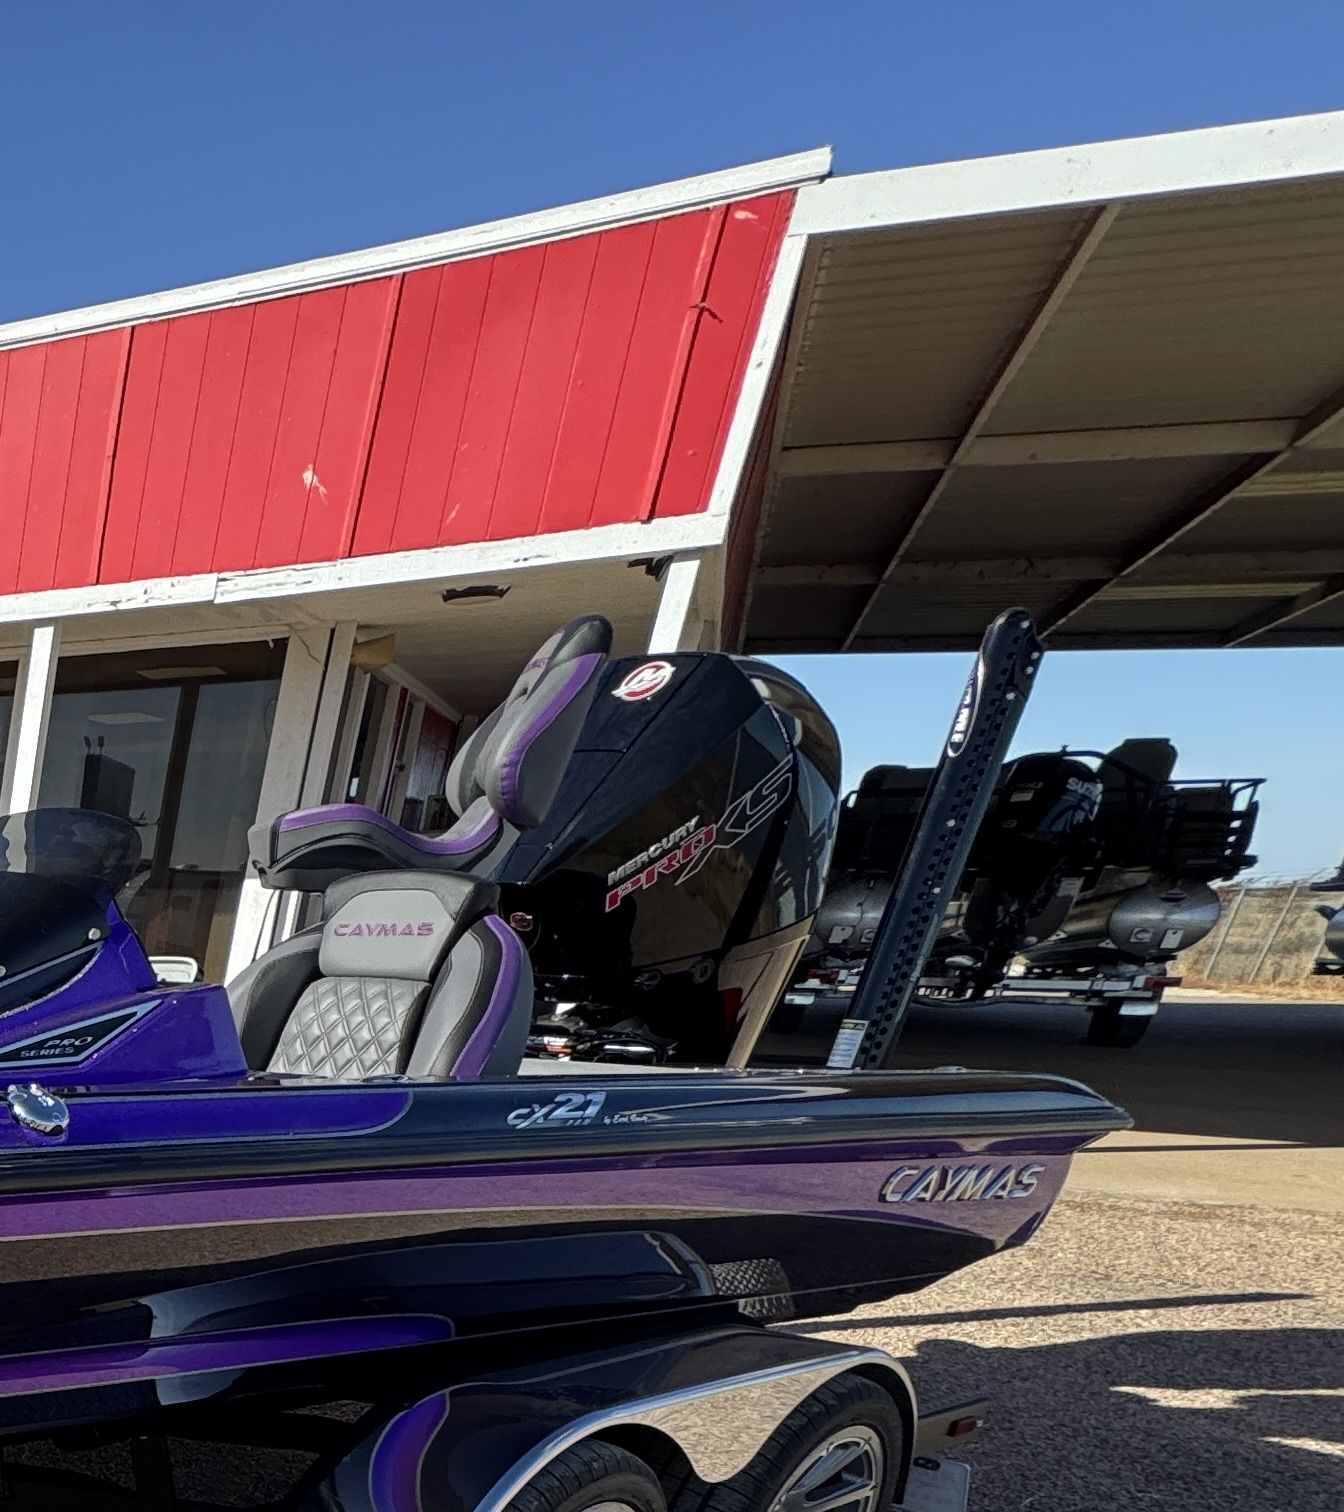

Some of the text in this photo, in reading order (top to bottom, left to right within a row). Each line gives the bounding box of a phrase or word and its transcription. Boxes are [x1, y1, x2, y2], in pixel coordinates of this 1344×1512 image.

[607, 815, 701, 887] MERCURY
[605, 823, 717, 913] PRO
[334, 921, 435, 937] CAYMAS
[20, 1046, 75, 1058] SERIES
[43, 1036, 94, 1048] PRO
[879, 1163, 1046, 1204] CAYMAS
